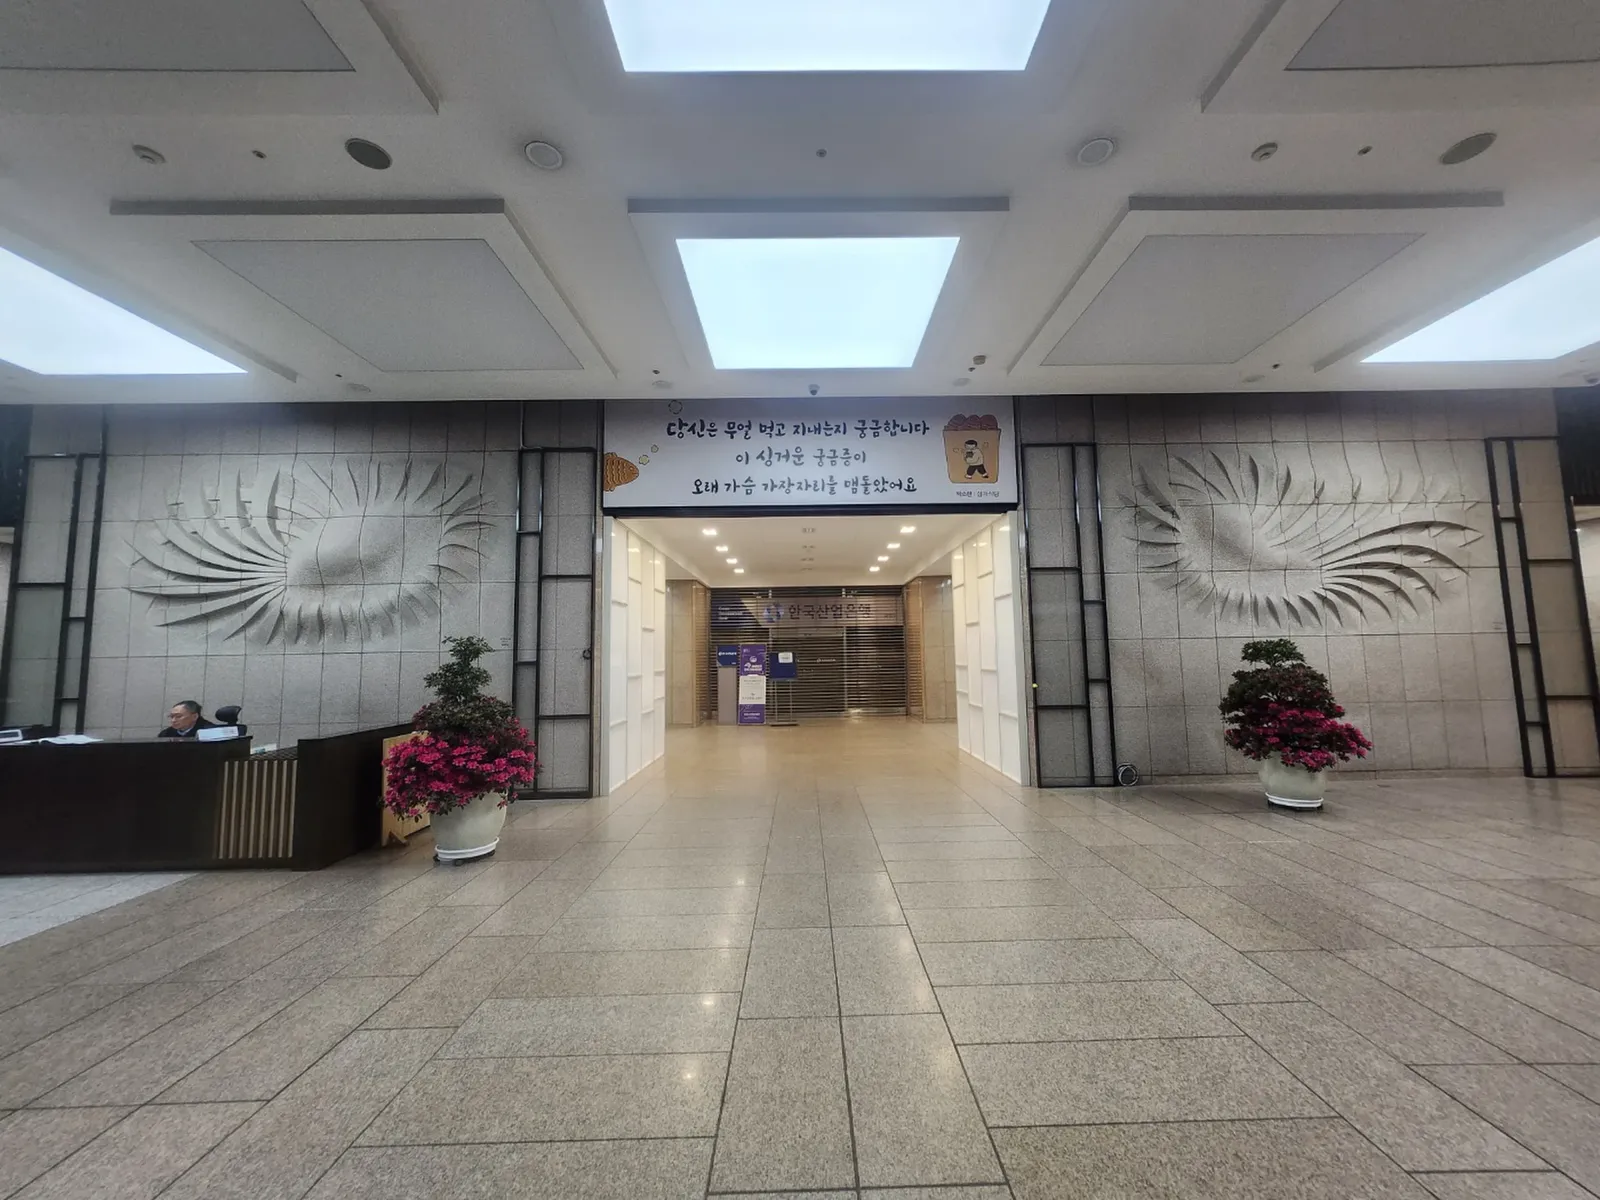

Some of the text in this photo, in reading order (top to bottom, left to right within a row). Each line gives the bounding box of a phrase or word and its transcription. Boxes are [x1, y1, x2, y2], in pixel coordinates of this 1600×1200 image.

[667, 418, 930, 440] 당신은 무얼 먹고 지내는지 궁금합니다
[736, 446, 866, 467] 이 싱거운 궁금증이
[692, 474, 917, 495] 오래 가슴 가장자리를 맴돌았어요
[788, 603, 871, 620] 한국산업은행
